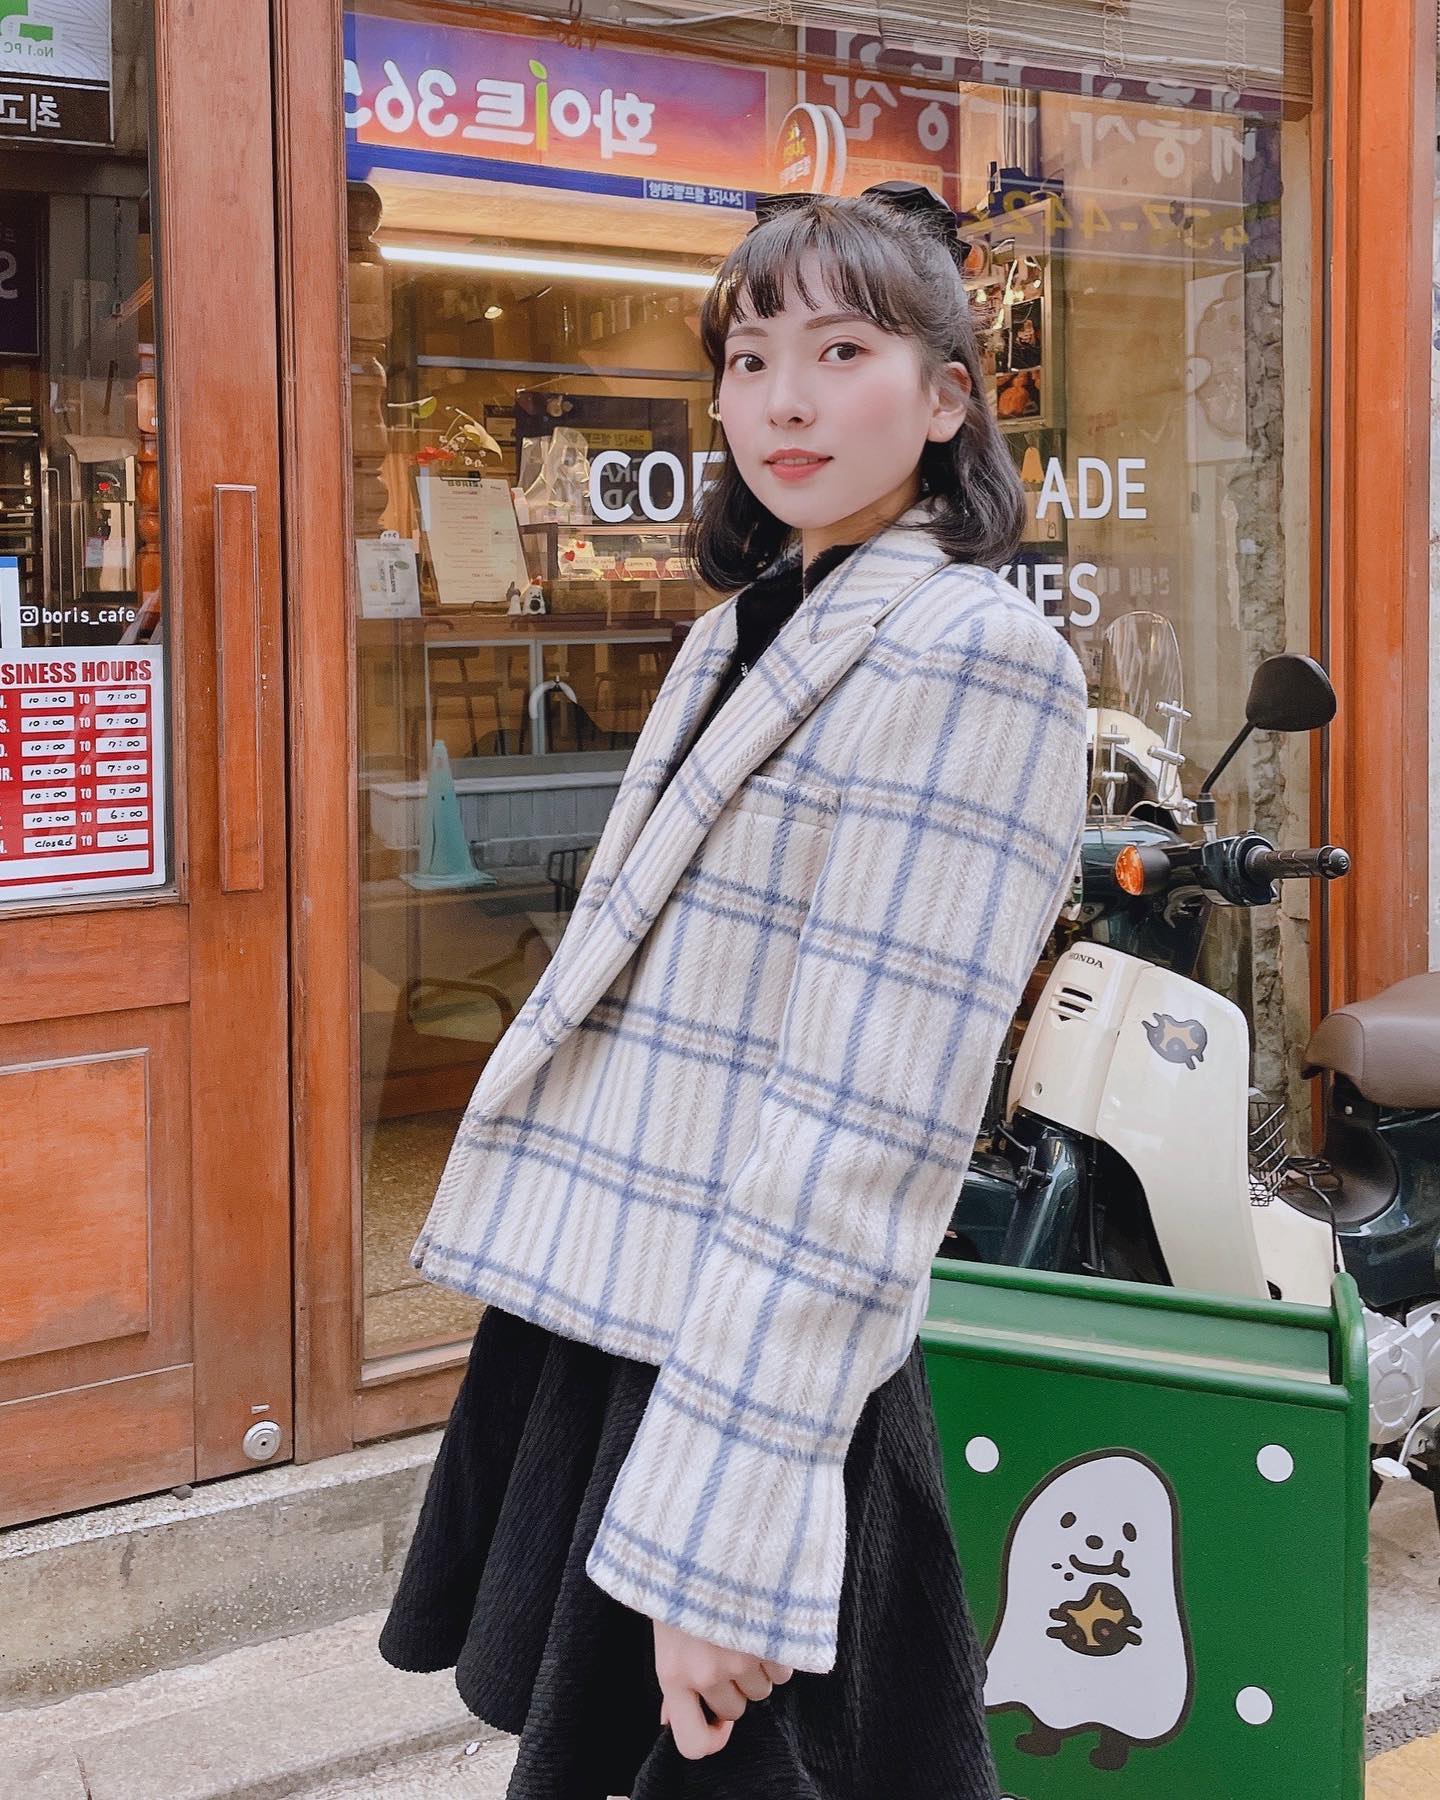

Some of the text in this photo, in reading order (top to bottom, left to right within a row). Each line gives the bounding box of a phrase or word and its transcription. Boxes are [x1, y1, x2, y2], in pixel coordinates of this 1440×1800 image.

[589, 450, 728, 523] COF
[1035, 456, 1148, 520] ADE
[998, 562, 1101, 628] IES
[42, 606, 136, 626] boris_cafe
[81, 659, 152, 683] HOURS
[79, 693, 91, 705] TO
[79, 717, 91, 729] TO
[79, 740, 91, 752] TO
[80, 764, 92, 776] TO
[80, 788, 92, 800] TO
[80, 811, 93, 823] TO
[81, 835, 93, 847] TO
[1069, 952, 1105, 970] HONDA
